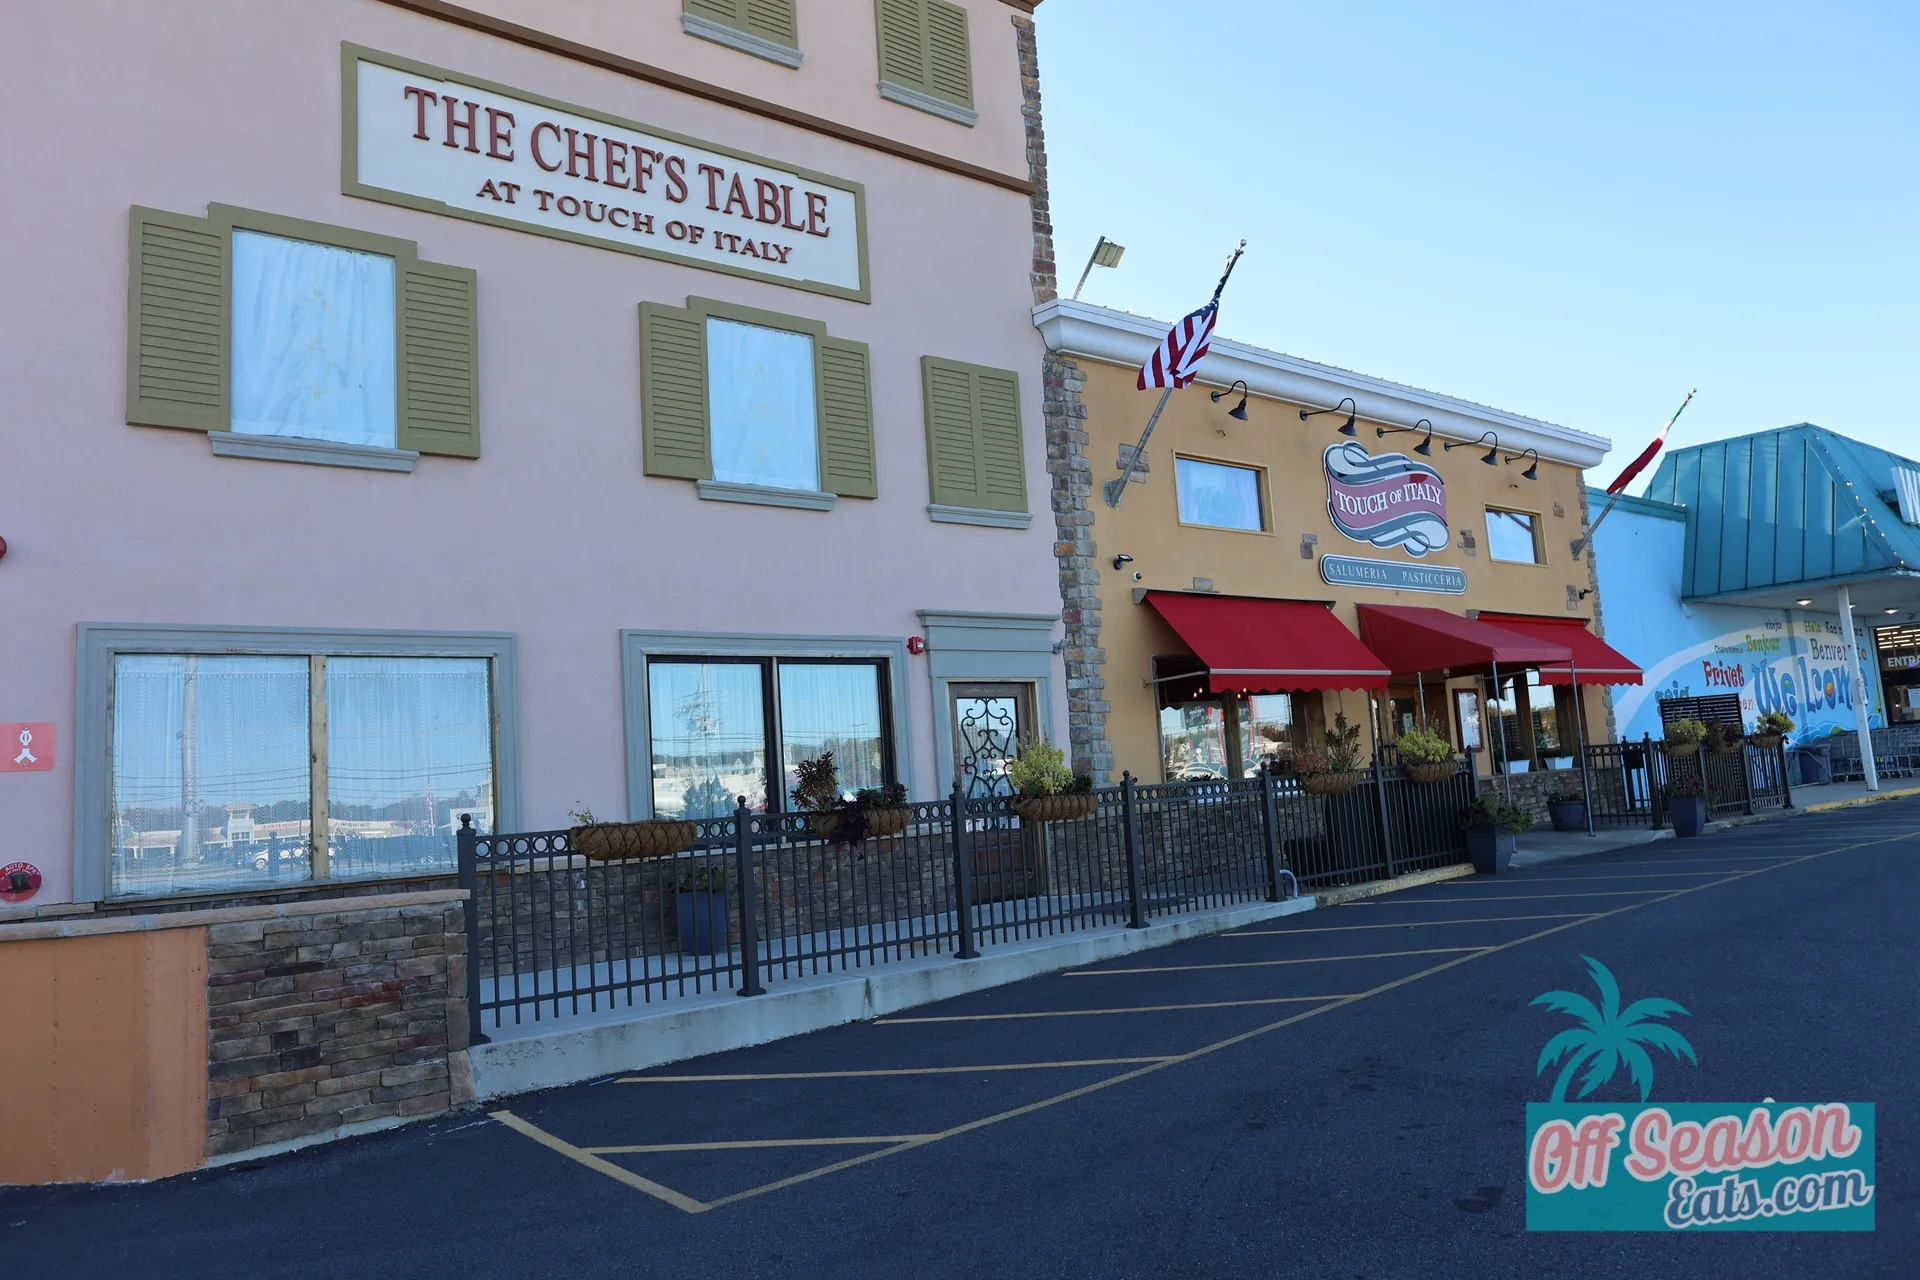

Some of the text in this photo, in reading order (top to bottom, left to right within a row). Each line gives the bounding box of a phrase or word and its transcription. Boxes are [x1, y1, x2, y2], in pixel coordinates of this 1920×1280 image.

[404, 85, 831, 238] THE CHEF'S TABLE
[476, 178, 794, 264] AT TOUCH OF ITALY
[1334, 482, 1442, 516] TOUCH OF ITALY
[1329, 563, 1463, 587] SALUMERIA PASTICCERIA
[1745, 634, 1780, 656] Bonjour
[1702, 659, 1745, 688] Privet
